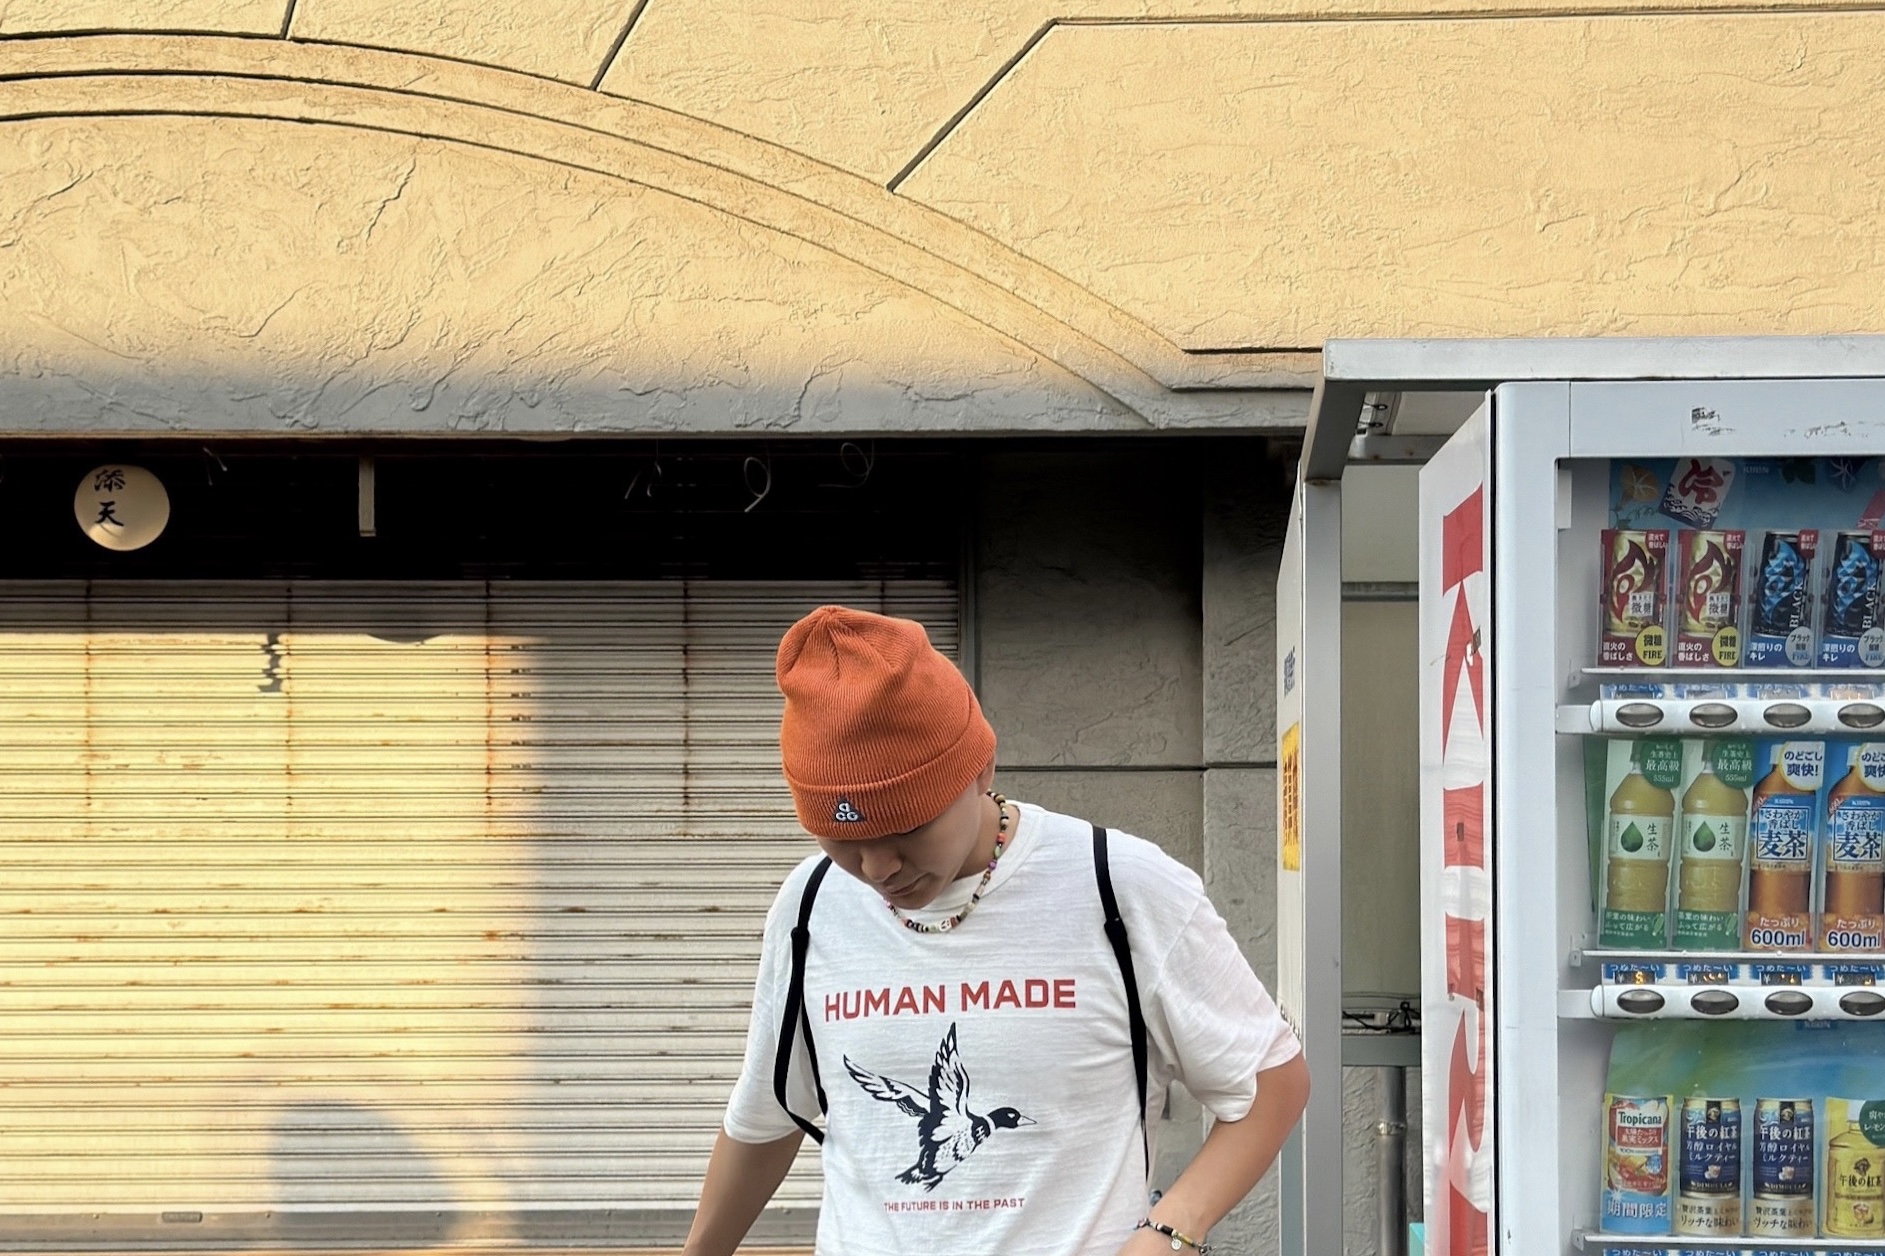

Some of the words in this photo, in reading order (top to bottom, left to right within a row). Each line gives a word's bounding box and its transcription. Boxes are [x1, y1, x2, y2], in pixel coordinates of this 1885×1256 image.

[1789, 580, 1803, 629] BLACK
[1862, 583, 1876, 629] BLACK
[1603, 642, 1625, 651] 直火の
[1678, 643, 1702, 652] 直火の
[1603, 652, 1633, 661] 香ばしさ
[1643, 650, 1662, 660] FIRE
[1678, 653, 1710, 662] 香ばしさ
[1719, 651, 1736, 660] FIRE
[1749, 653, 1766, 662] キレ
[1822, 654, 1838, 662] キレ
[1784, 751, 1823, 761] のどごし
[1646, 760, 1679, 772] 最高級
[1717, 759, 1752, 772] 最高級
[1787, 763, 1818, 776] 爽快!
[1764, 809, 1800, 820] さわやか
[1842, 811, 1879, 821] さわやか
[1768, 820, 1800, 830] 香ばし
[1846, 821, 1876, 831] 香ばし
[1646, 823, 1659, 851] 生茶
[1719, 822, 1732, 851] 生茶
[1758, 829, 1807, 857] 麦茶
[1836, 831, 1881, 859] 麦茶
[1760, 916, 1799, 927] たっぷり
[1837, 918, 1876, 929] たっぷり
[1751, 928, 1805, 946] 600ml
[1828, 930, 1881, 948] 600ml
[825, 985, 945, 1022] HUMAN
[961, 979, 1076, 1012] MADE
[1618, 1111, 1662, 1126] Tropicana
[1687, 1124, 1738, 1140] 午後の紅茶
[1760, 1125, 1811, 1140] 午後の紅茶
[1840, 1174, 1883, 1187] 午後の紅茶
[884, 1203, 899, 1212] THE
[901, 1201, 936, 1212] FUTURE
[939, 1201, 949, 1210] IS
[952, 1201, 963, 1210] IN
[967, 1199, 990, 1210] THE
[994, 1198, 1025, 1208] PAST
[1608, 1201, 1667, 1217] 期間限定
